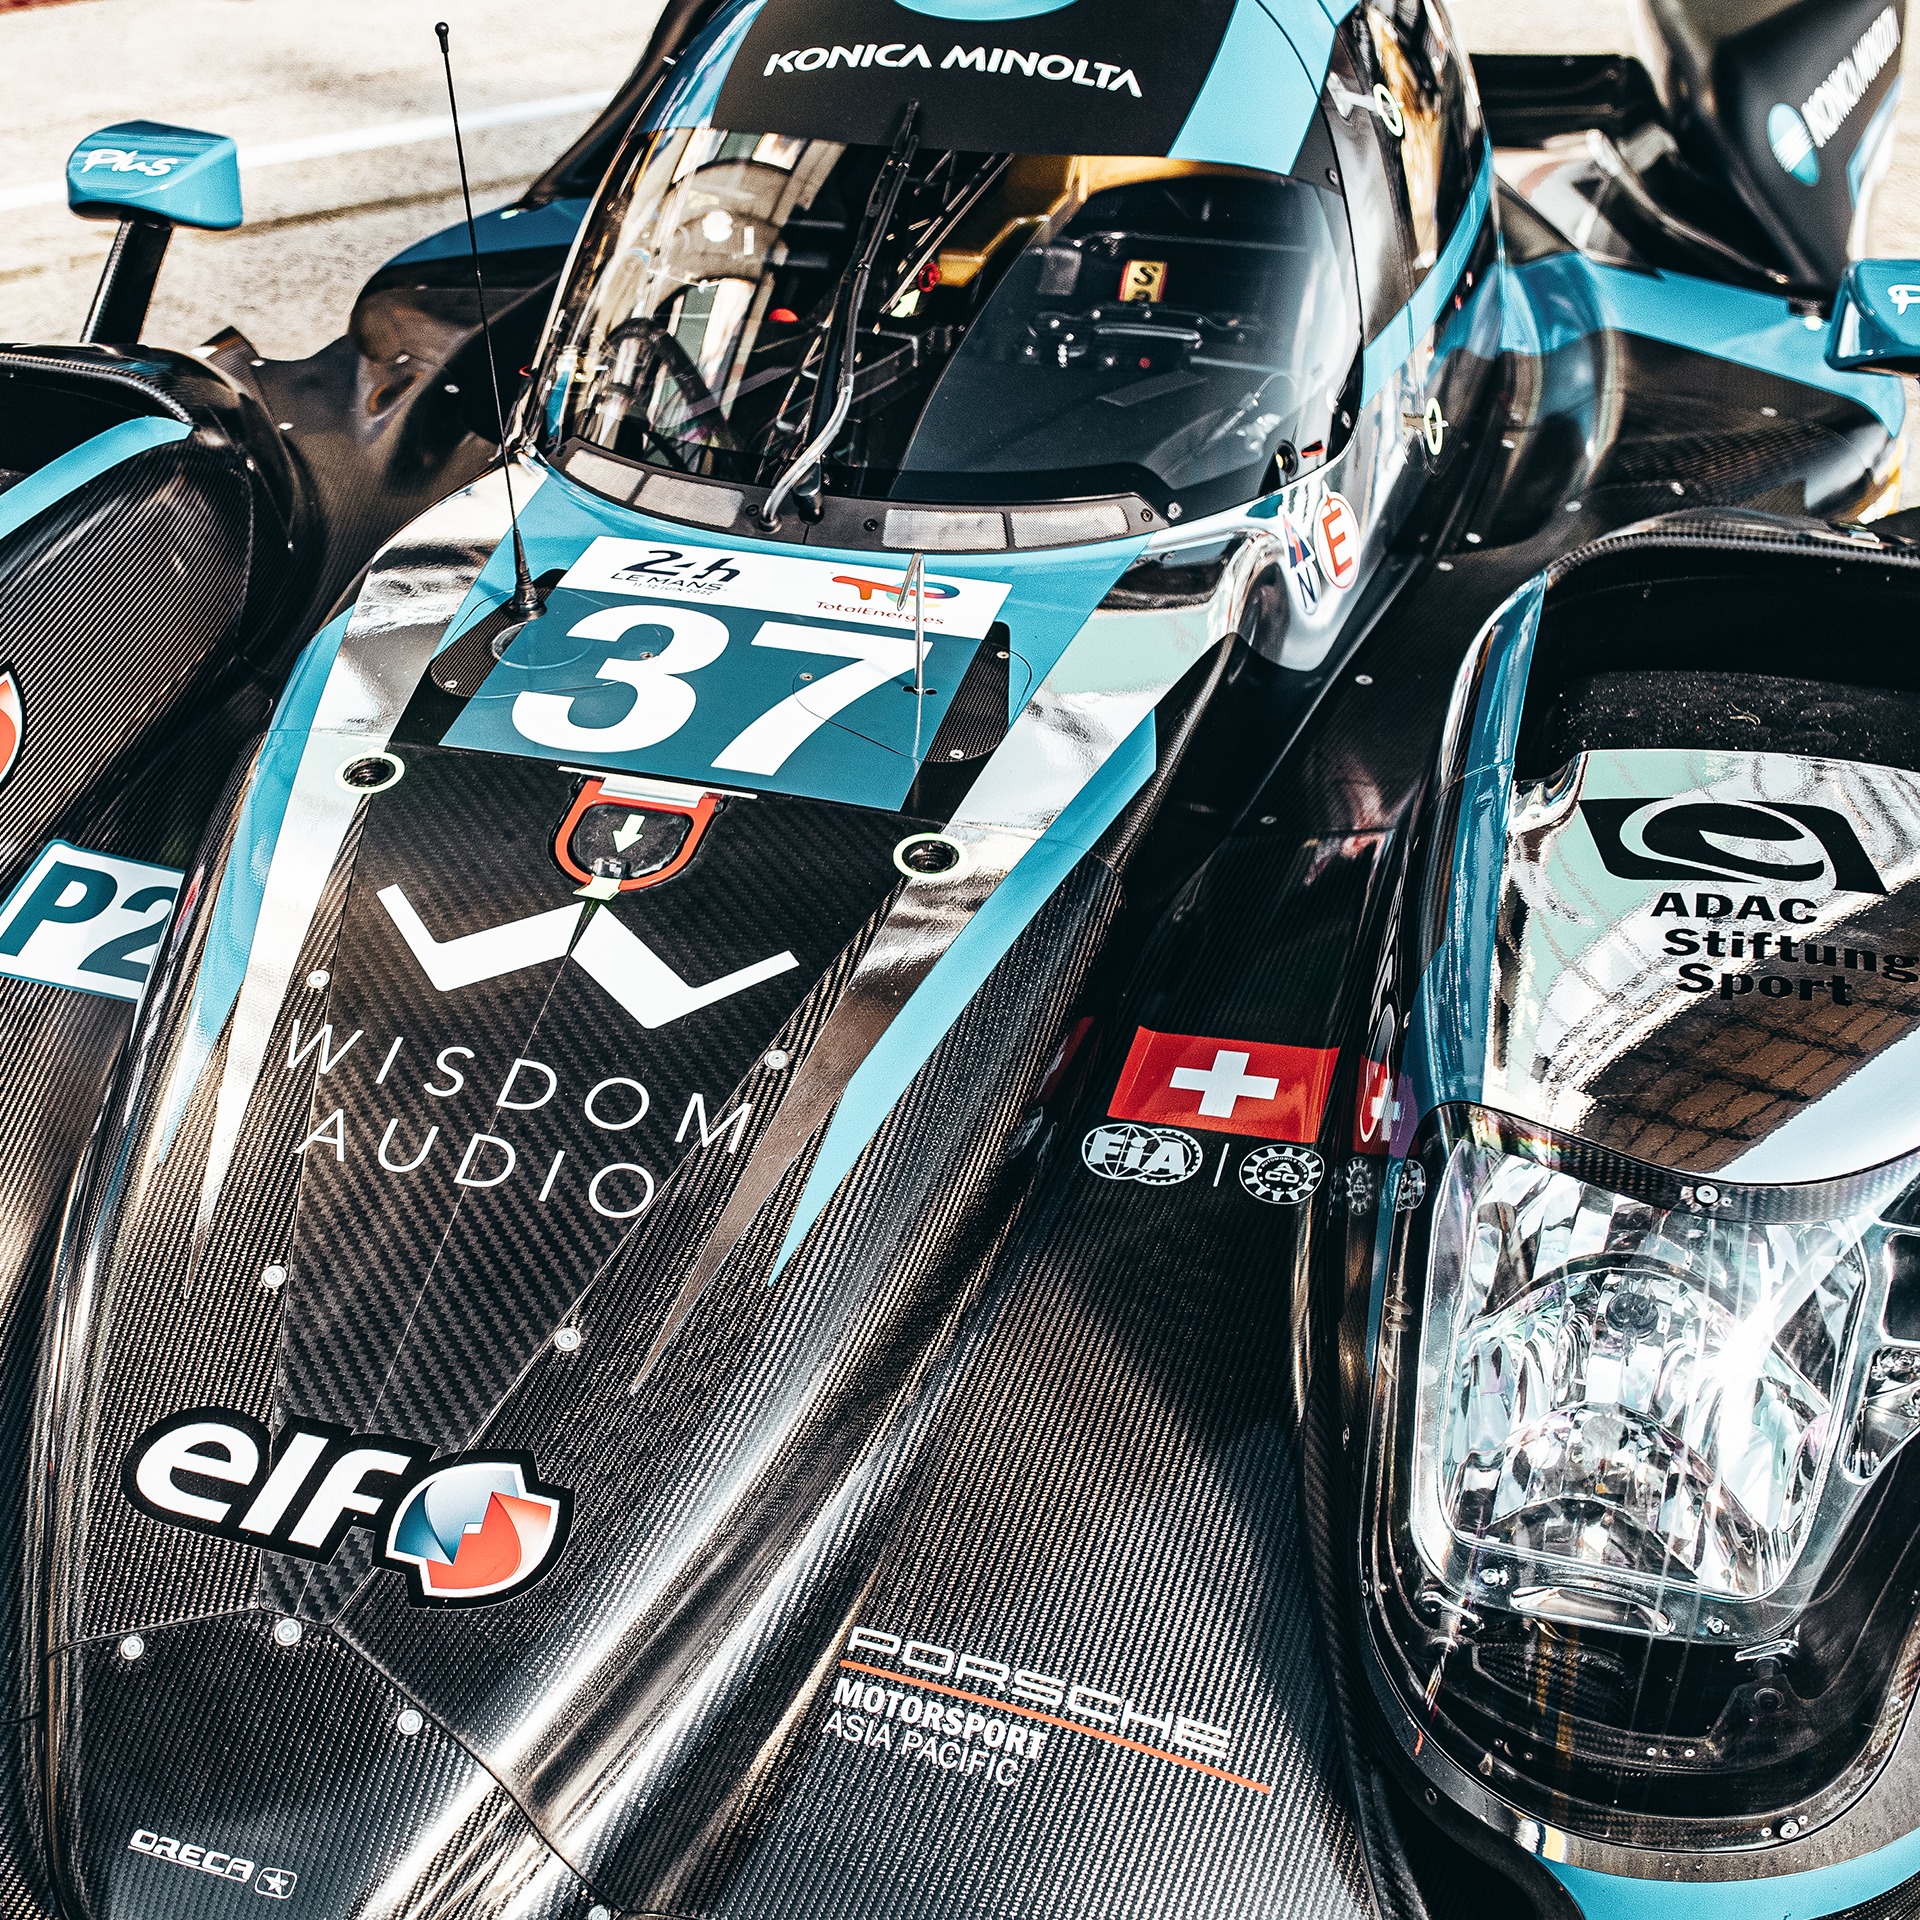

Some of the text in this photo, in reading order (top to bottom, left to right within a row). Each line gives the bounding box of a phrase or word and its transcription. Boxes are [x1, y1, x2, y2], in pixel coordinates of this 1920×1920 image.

[763, 44, 1142, 98] KONICA MINOLTA
[81, 149, 179, 177] Plus
[610, 572, 724, 591] LE MANS
[816, 601, 945, 626] TotalEnerges
[511, 604, 934, 777] 37
[0, 861, 178, 984] P2
[1650, 892, 1818, 925] ADAC
[1661, 928, 1920, 983] Stiftung
[1676, 963, 1853, 1006] Sport
[286, 1019, 752, 1154] WISDOM
[294, 1108, 656, 1219] AUDIO
[136, 1422, 411, 1549] elf
[833, 1677, 1049, 1760] MOTORSPORT
[847, 1626, 1232, 1760] PORSCHE
[822, 1710, 1019, 1787] ASIA PACIFIC
[129, 1828, 256, 1882] ORECA
